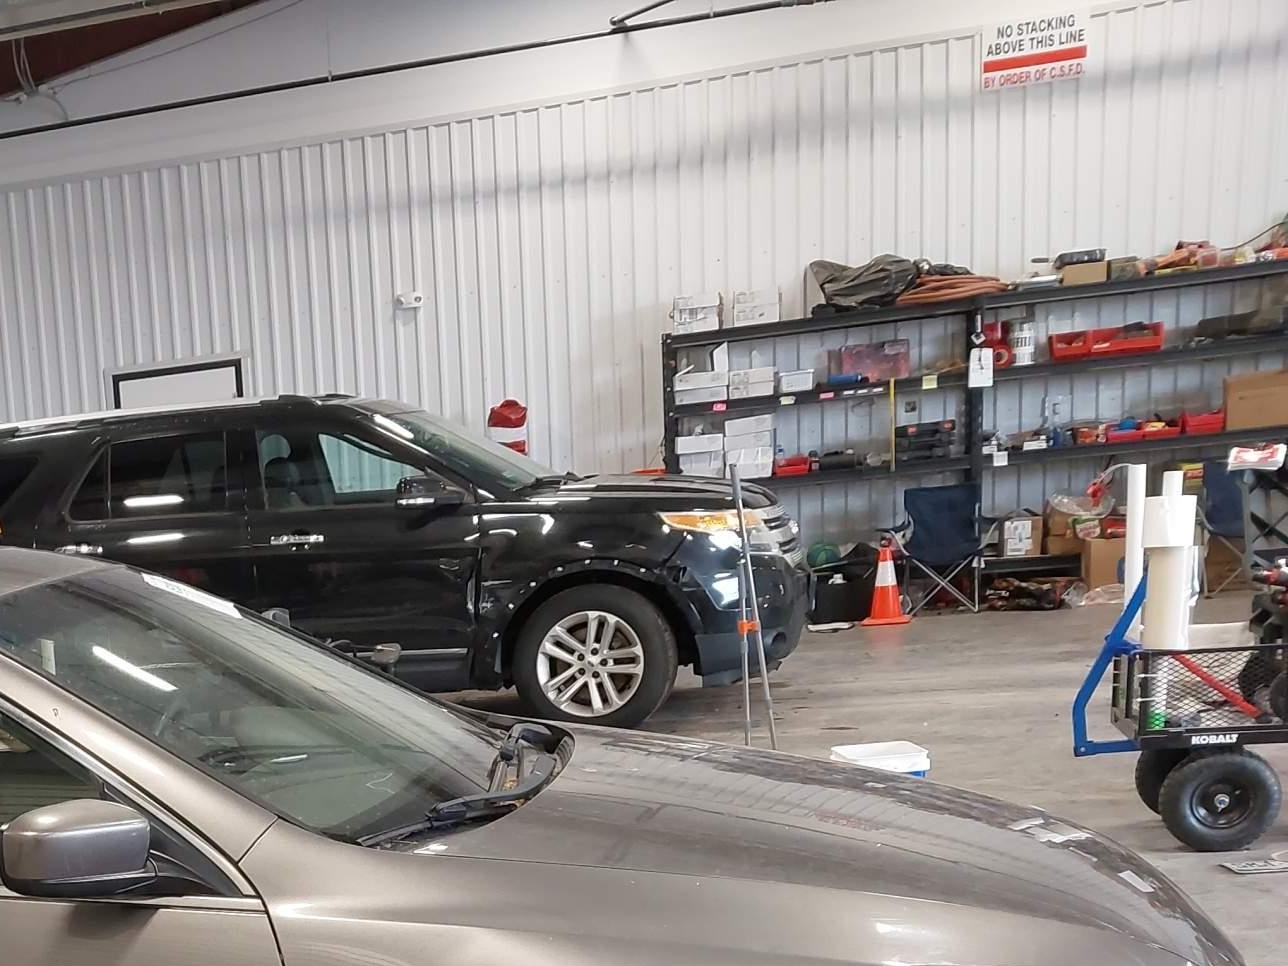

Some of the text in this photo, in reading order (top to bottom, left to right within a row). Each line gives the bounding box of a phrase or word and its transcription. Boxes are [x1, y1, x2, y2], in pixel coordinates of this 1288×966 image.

[997, 14, 1076, 39] NO STACKING
[986, 29, 1085, 57] ABOVE THIS LINE
[983, 76, 996, 89] BY
[998, 70, 1031, 87] ORDER
[1033, 69, 1047, 82] OF
[1191, 734, 1239, 745] KOBALT
